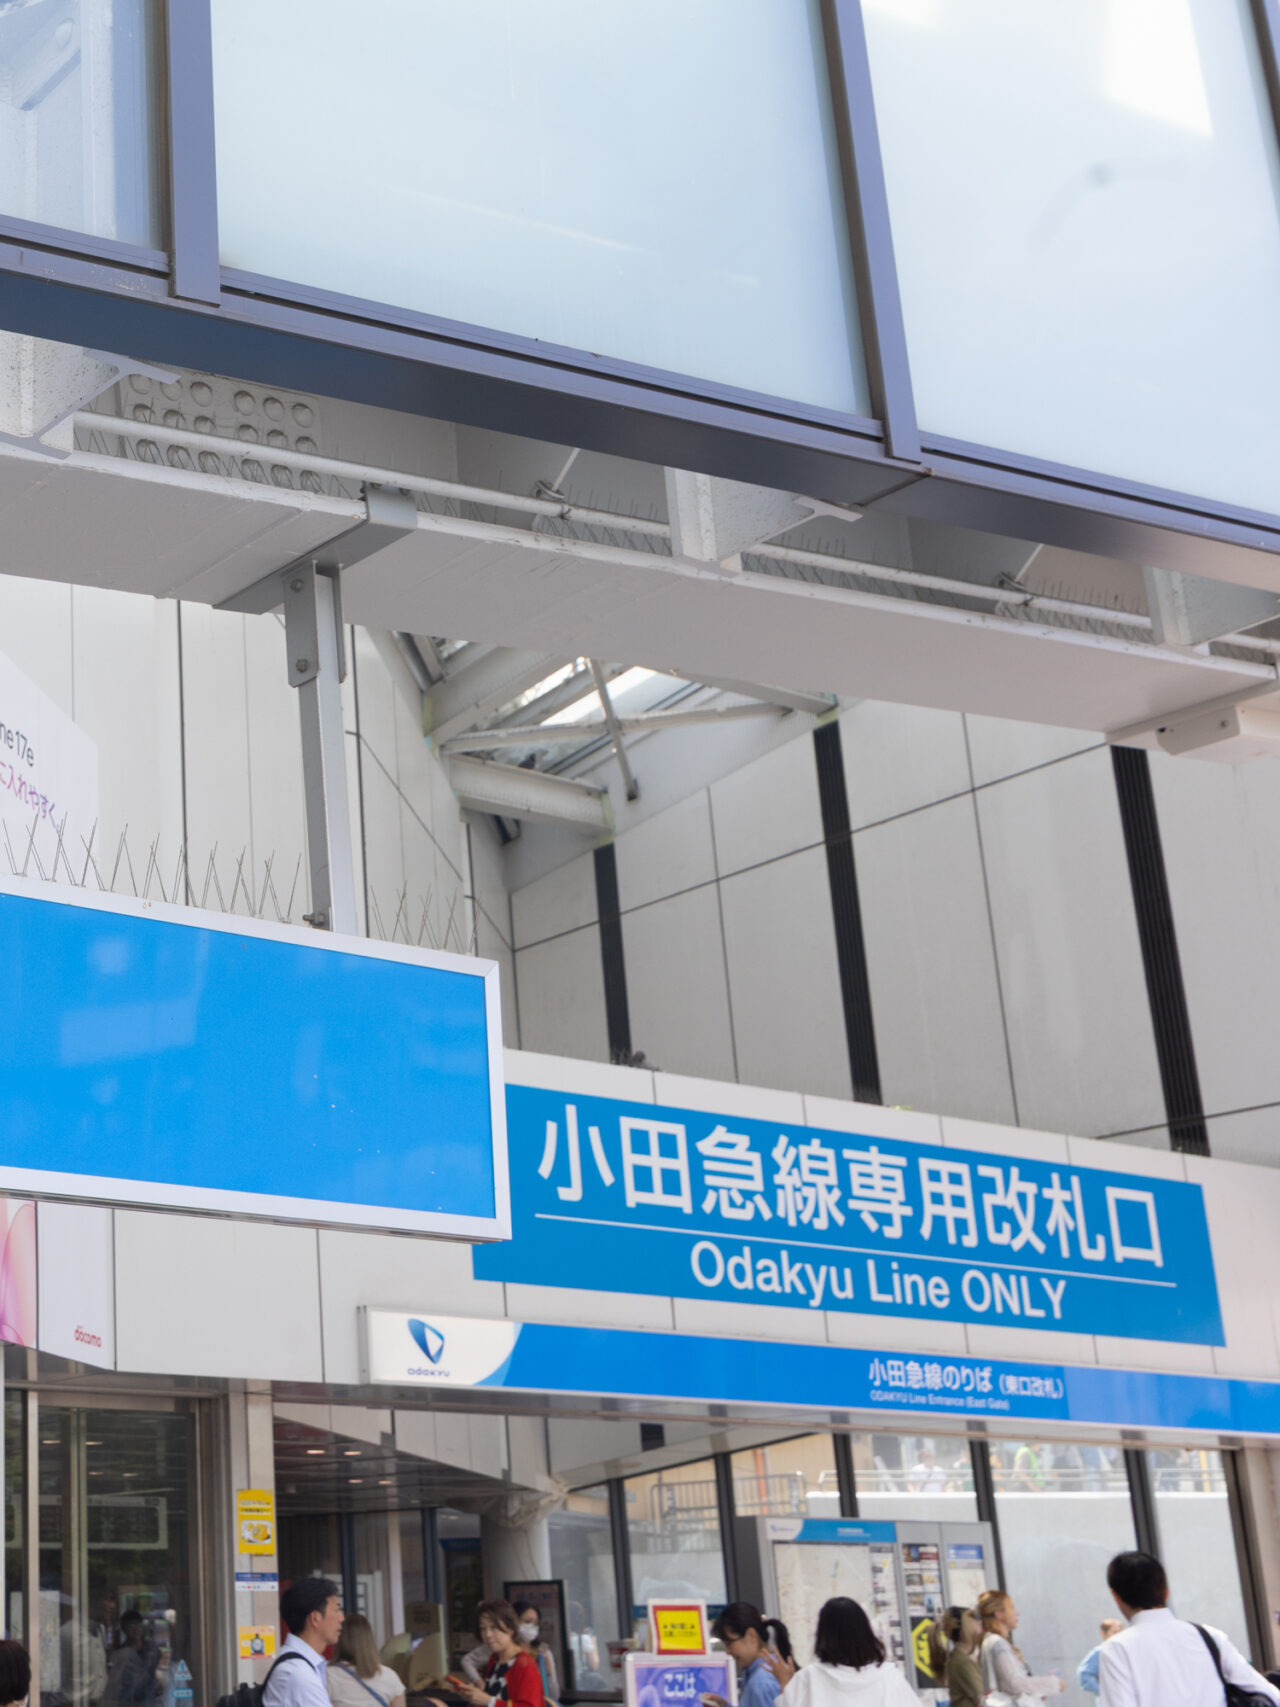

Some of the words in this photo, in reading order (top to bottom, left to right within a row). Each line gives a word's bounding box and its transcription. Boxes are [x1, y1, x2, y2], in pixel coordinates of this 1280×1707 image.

[536, 1103, 1165, 1268] 小田急線専用改札口
[689, 1239, 854, 1308] Odakyu
[867, 1258, 951, 1308] Line
[961, 1269, 1068, 1320] ONLY
[869, 1358, 993, 1392] 小田急線のりば
[909, 1391, 926, 1404] Line
[928, 1393, 965, 1407] Entrance
